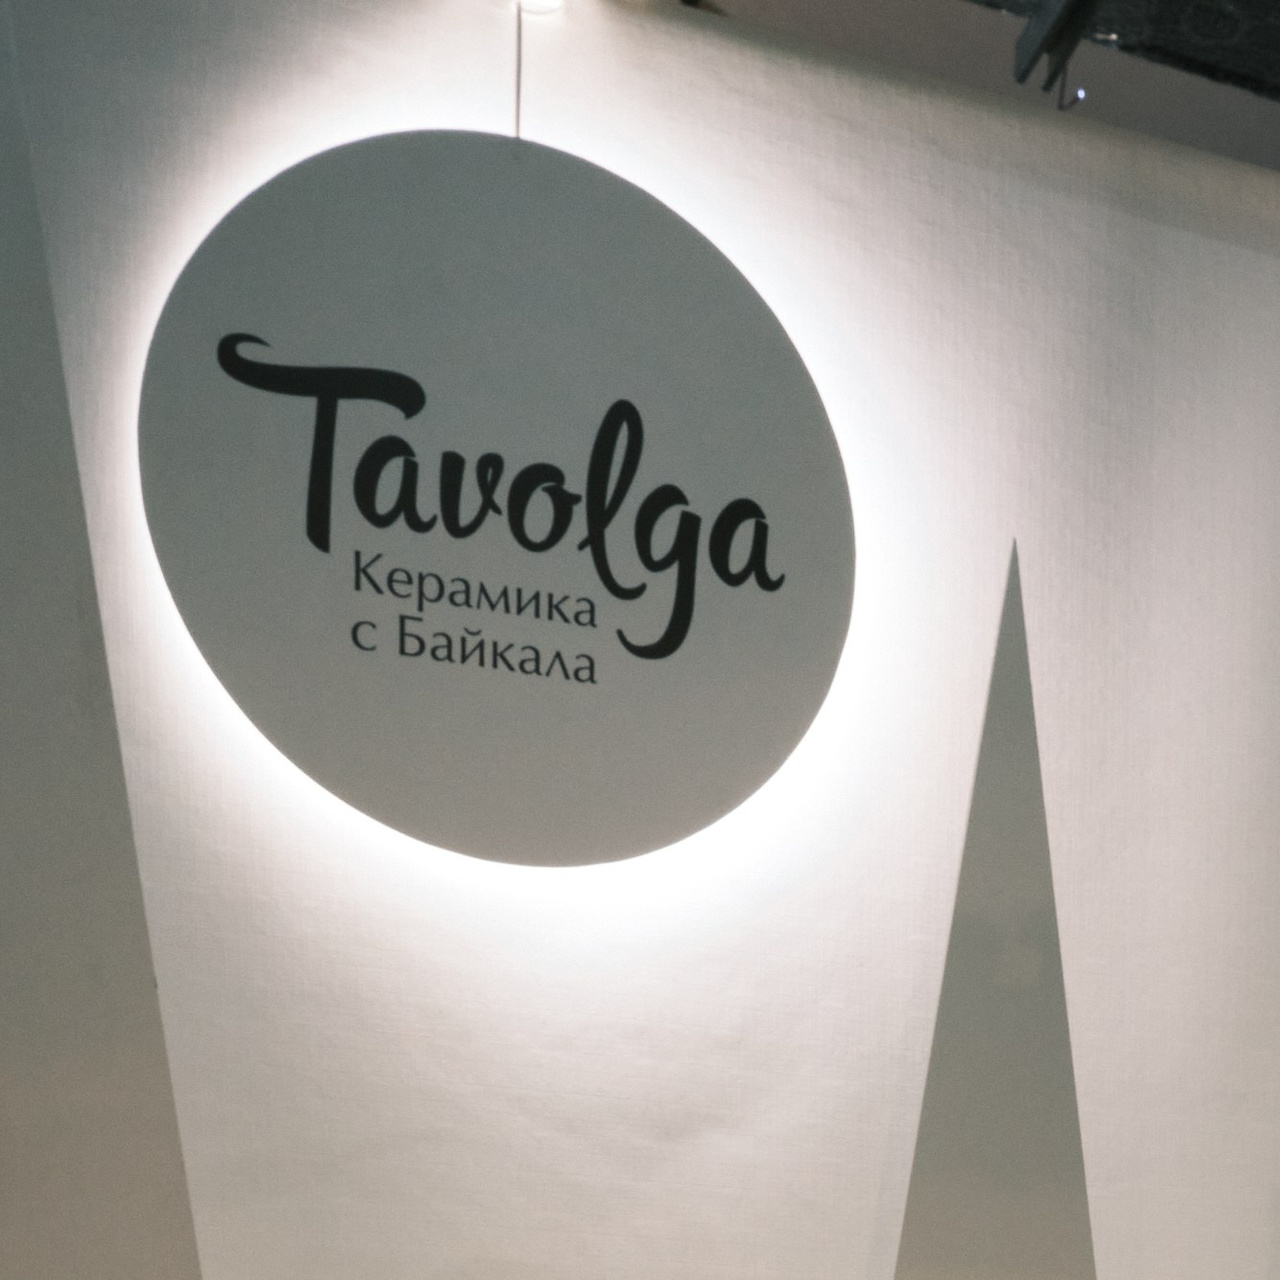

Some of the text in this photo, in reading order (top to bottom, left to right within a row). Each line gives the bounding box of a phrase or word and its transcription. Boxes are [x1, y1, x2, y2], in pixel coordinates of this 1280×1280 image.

[216, 332, 786, 660] Tavolga
[351, 549, 598, 628] Керамика
[349, 613, 598, 686] с Байкала
